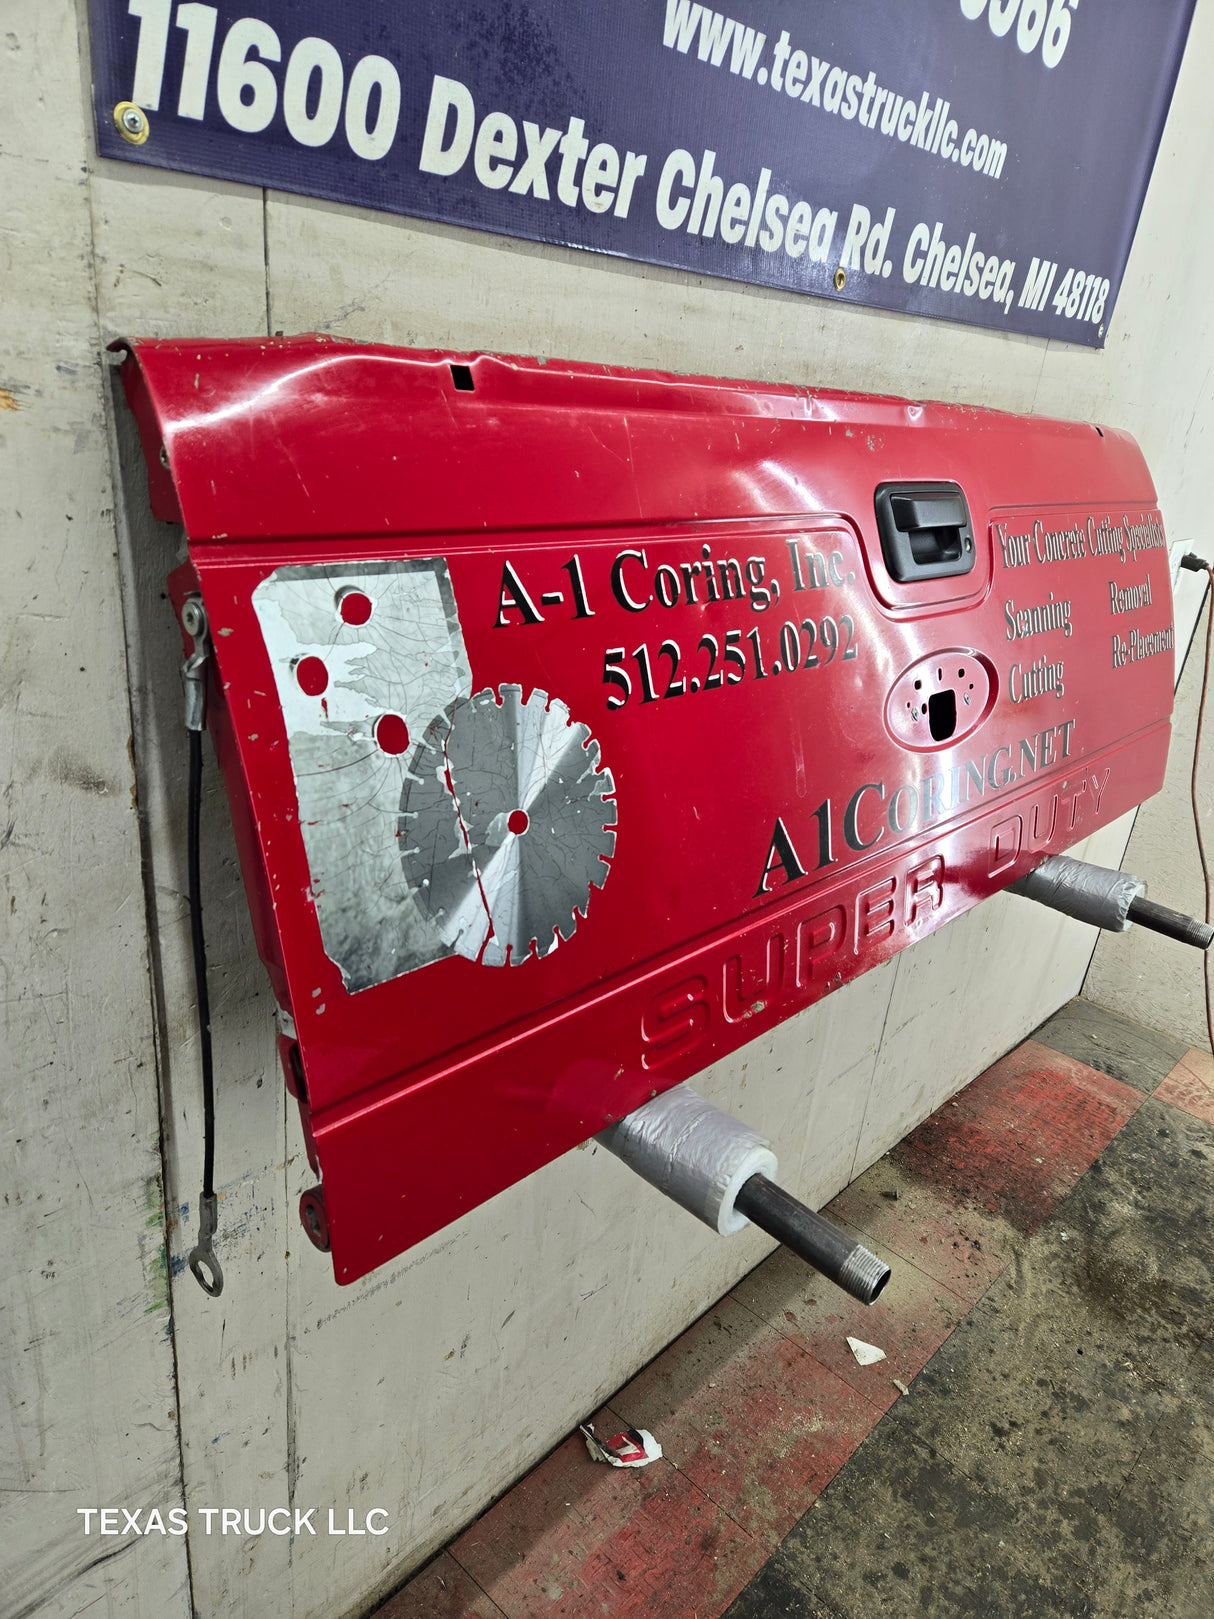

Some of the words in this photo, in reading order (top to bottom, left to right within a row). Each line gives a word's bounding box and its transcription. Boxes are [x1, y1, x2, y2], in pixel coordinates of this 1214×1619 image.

[662, 0, 1008, 179] www.texastruckllc.com
[128, 0, 401, 161] 11600
[418, 75, 647, 219] Dexter
[655, 148, 839, 261] Chelsea
[840, 204, 896, 278] Rd.
[902, 222, 1016, 314] Chelsea,
[1018, 256, 1058, 311] MI
[1052, 267, 1110, 324] 48118
[996, 522, 1031, 569] Your
[1032, 519, 1087, 564] Concrete
[1086, 516, 1126, 563] Cutting
[492, 553, 596, 629] A-1
[610, 543, 781, 613] Coring,
[785, 538, 856, 591] Inc.
[1004, 592, 1073, 642] Scanning
[1108, 574, 1152, 615] Removal
[602, 614, 858, 711] 512.251.0292
[1009, 654, 1064, 704] Cutting
[1111, 624, 1175, 669] Re-Placement
[640, 853, 946, 1071] SUPER
[987, 767, 1111, 879] DUTY
